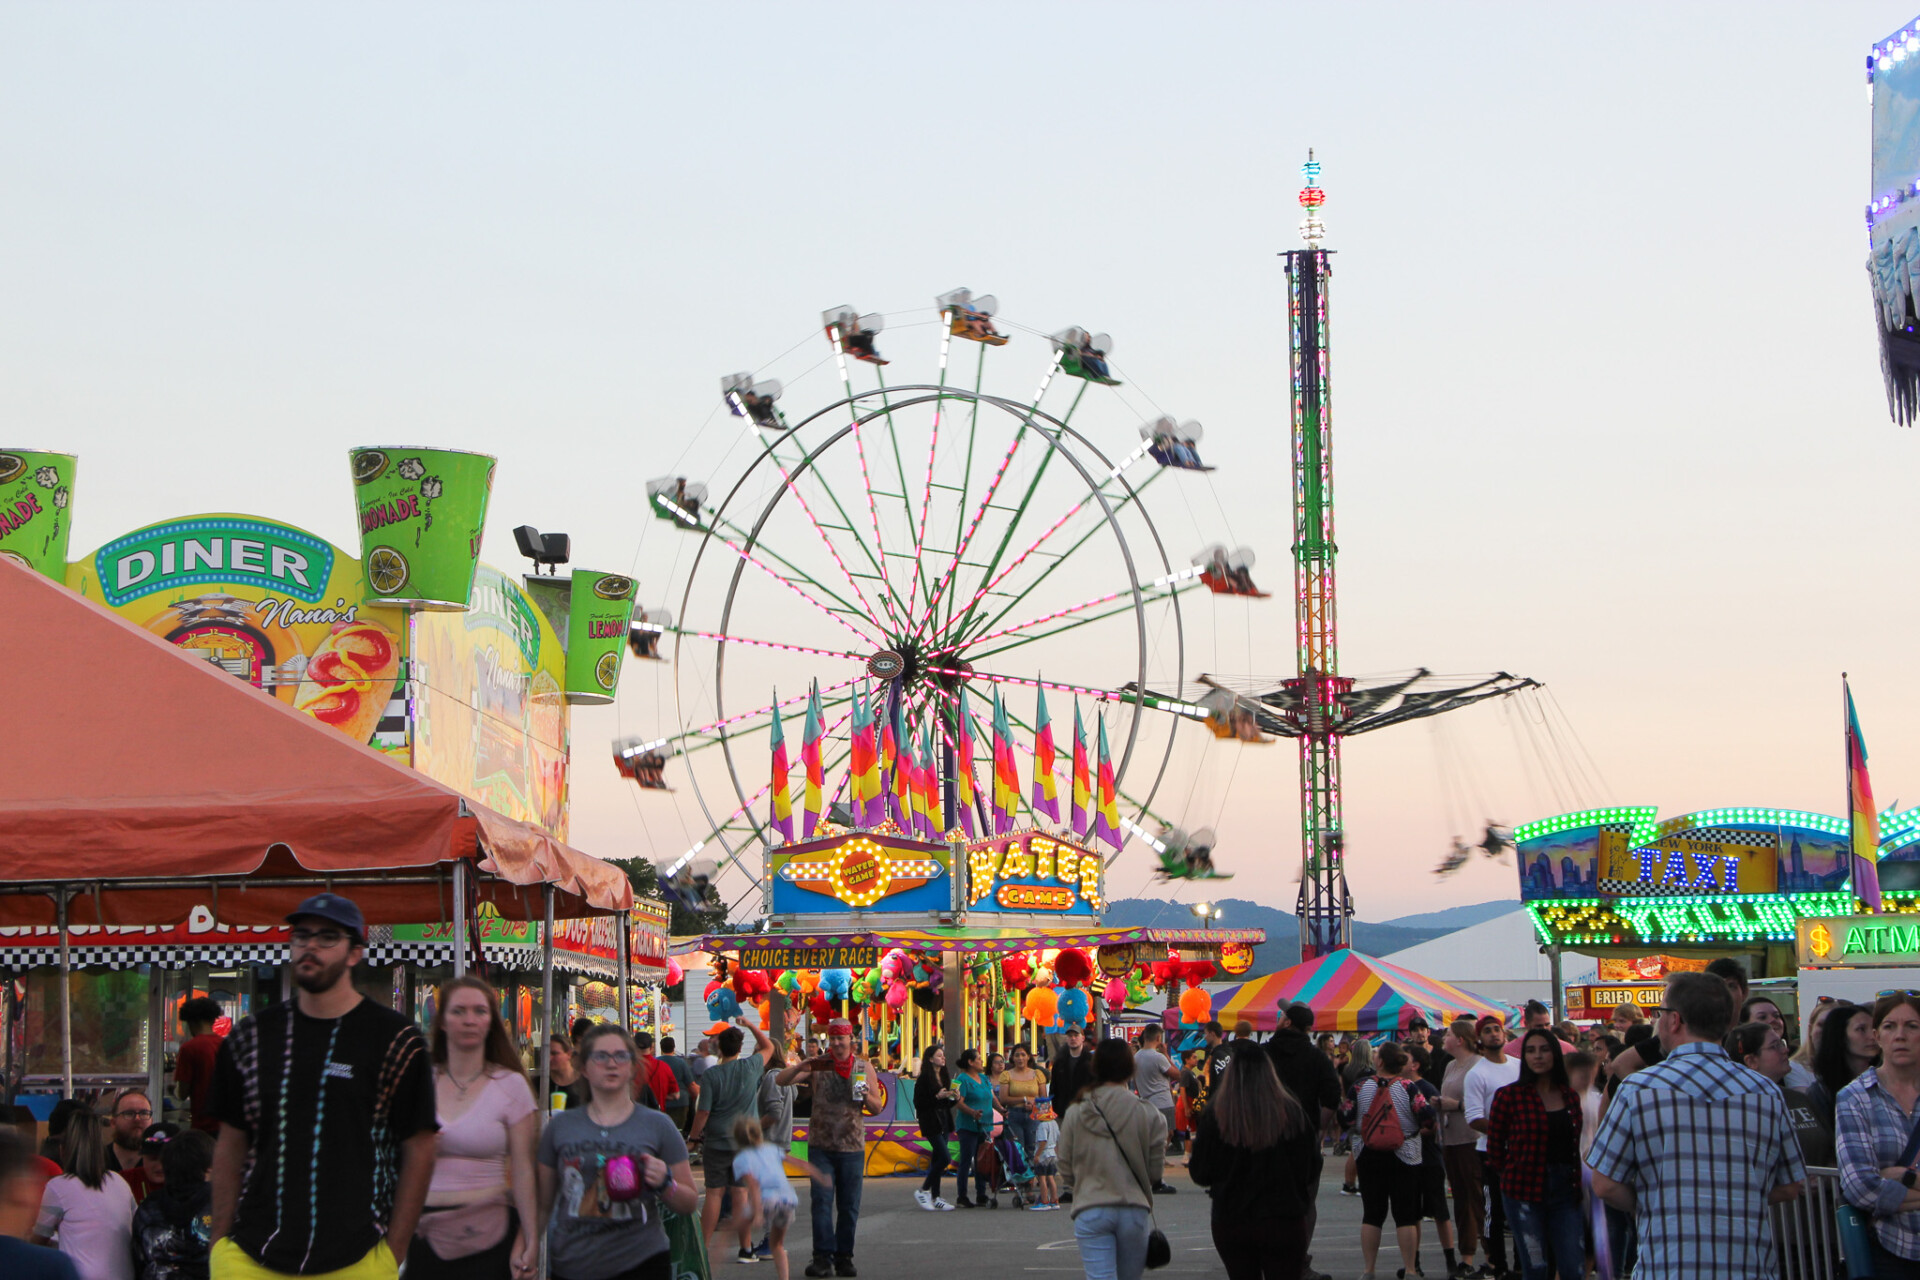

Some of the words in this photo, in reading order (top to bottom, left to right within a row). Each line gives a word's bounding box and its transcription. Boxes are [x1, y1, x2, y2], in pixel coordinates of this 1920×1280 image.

[117, 537, 313, 591] DINER
[255, 598, 358, 629] Nana's
[468, 584, 534, 656] DINER
[1687, 841, 1724, 853] YORK
[843, 859, 876, 877] WATER
[848, 870, 875, 885] GAME
[969, 837, 1102, 911] WATER
[1631, 848, 1741, 893] TAXI
[1007, 889, 1067, 906] GAME
[1843, 924, 1920, 955] ATM
[743, 949, 789, 967] CHOICE
[793, 948, 836, 967] EVERY
[840, 947, 873, 965] RACE
[1595, 990, 1633, 1004] FRIED
